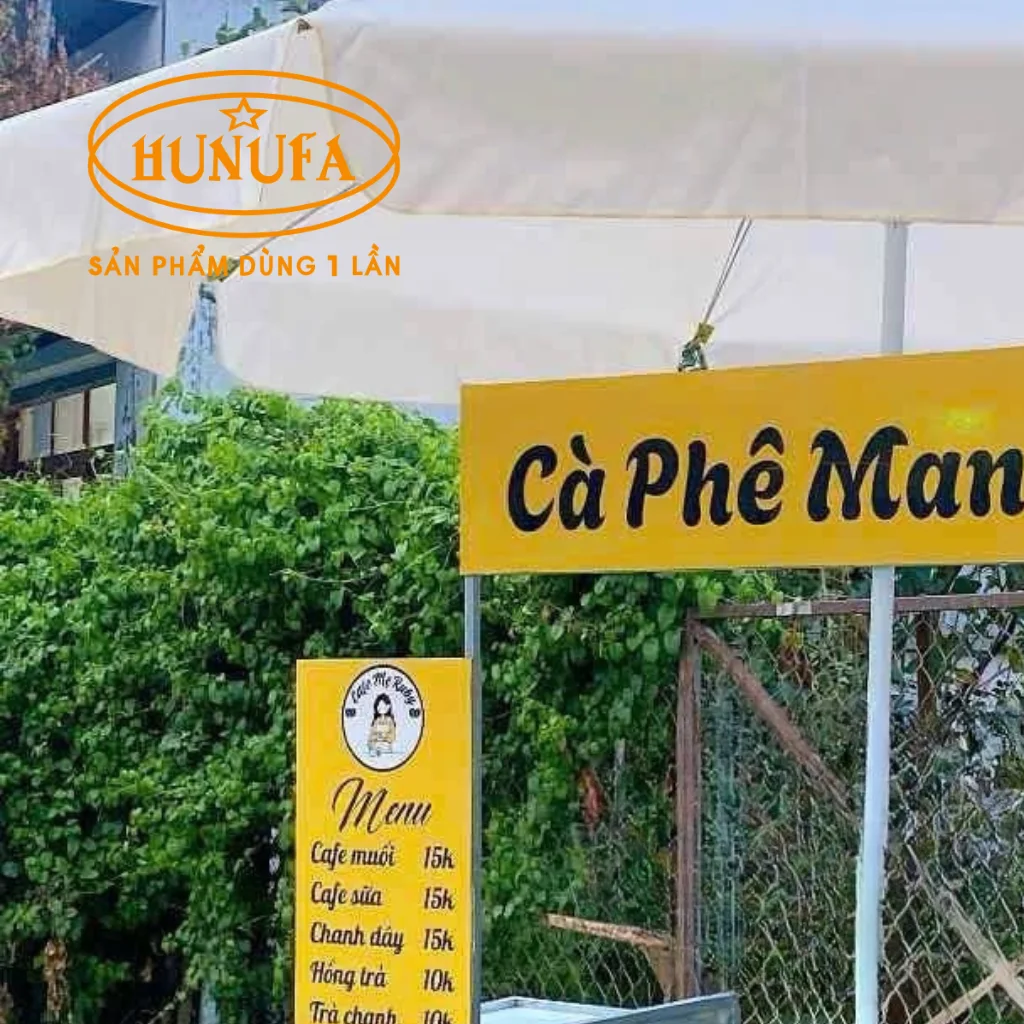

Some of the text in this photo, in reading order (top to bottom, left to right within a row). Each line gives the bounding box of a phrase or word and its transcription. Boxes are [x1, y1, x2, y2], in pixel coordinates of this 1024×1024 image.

[508, 435, 605, 532] Cà
[627, 427, 783, 528] Phê
[332, 778, 431, 833] Menu
[311, 841, 454, 870] Cafe muối 15k
[311, 882, 455, 910] Cafe sữa 15k
[311, 922, 365, 946] Chanh
[424, 929, 454, 951] 15k
[310, 959, 454, 992] Hồng trà 10k
[310, 1001, 339, 1024] Trà
